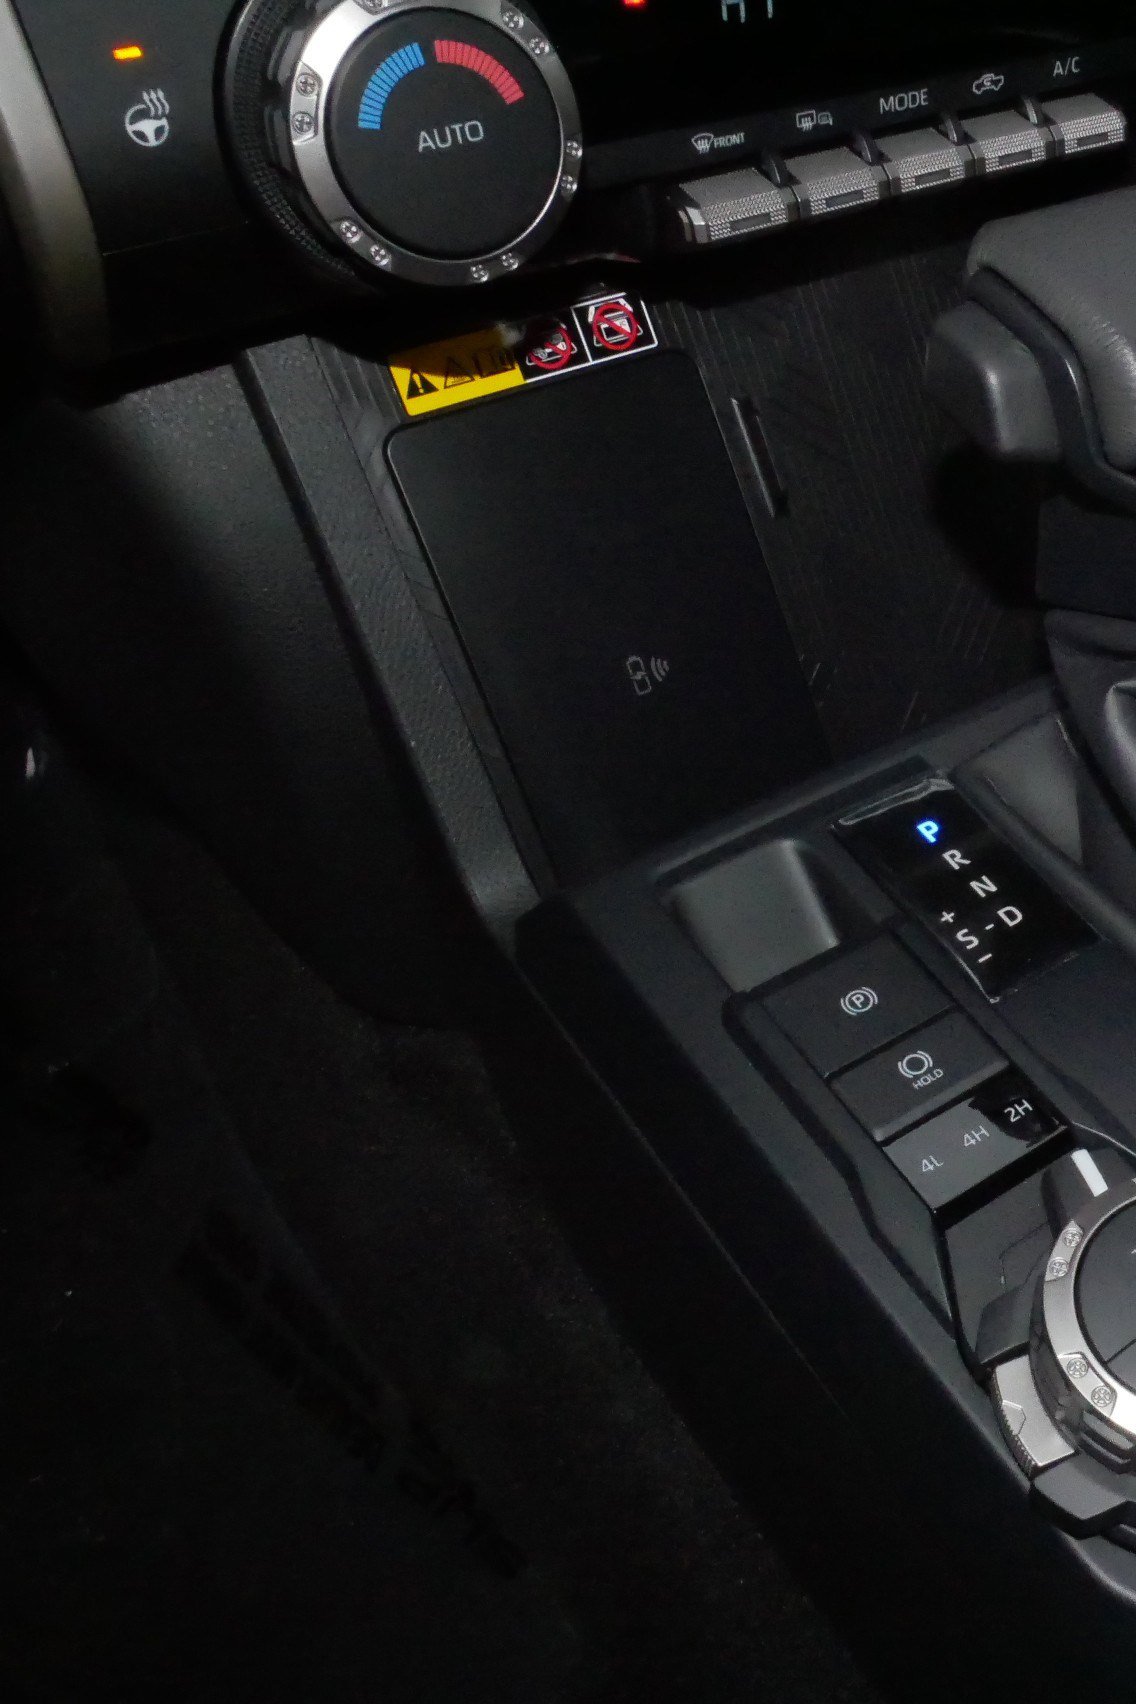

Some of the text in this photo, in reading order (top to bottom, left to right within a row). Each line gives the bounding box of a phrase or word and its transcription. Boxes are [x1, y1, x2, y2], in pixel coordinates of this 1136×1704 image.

[1052, 56, 1080, 77] A/C
[879, 88, 929, 114] MODE
[418, 120, 484, 153] AUTO
[713, 132, 745, 149] FRONT
[916, 819, 941, 844] P
[942, 849, 972, 870] R
[969, 875, 998, 898] N
[997, 905, 1023, 927] D
[955, 928, 979, 950] S
[912, 1068, 944, 1090] HOLD
[920, 1099, 1034, 1173] 4L 4H 2H
